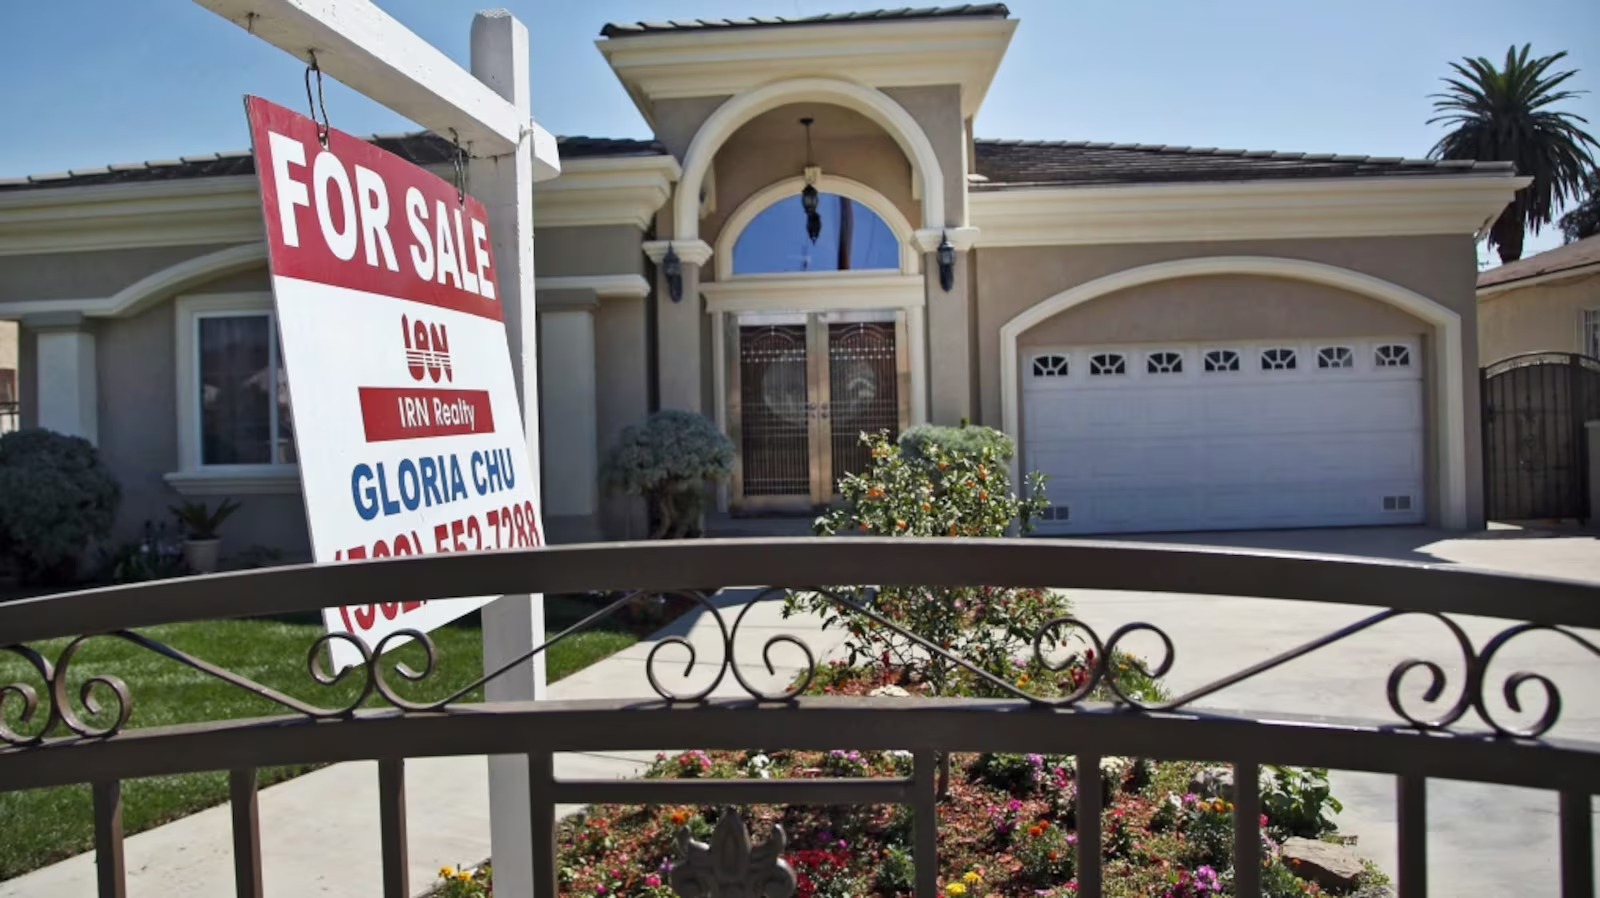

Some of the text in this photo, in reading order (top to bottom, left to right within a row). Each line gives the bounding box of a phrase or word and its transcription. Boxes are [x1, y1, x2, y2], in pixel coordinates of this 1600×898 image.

[268, 130, 496, 300] FOR SALE
[398, 396, 475, 431] IRN Realty
[351, 447, 515, 521] GLORIA CHU
